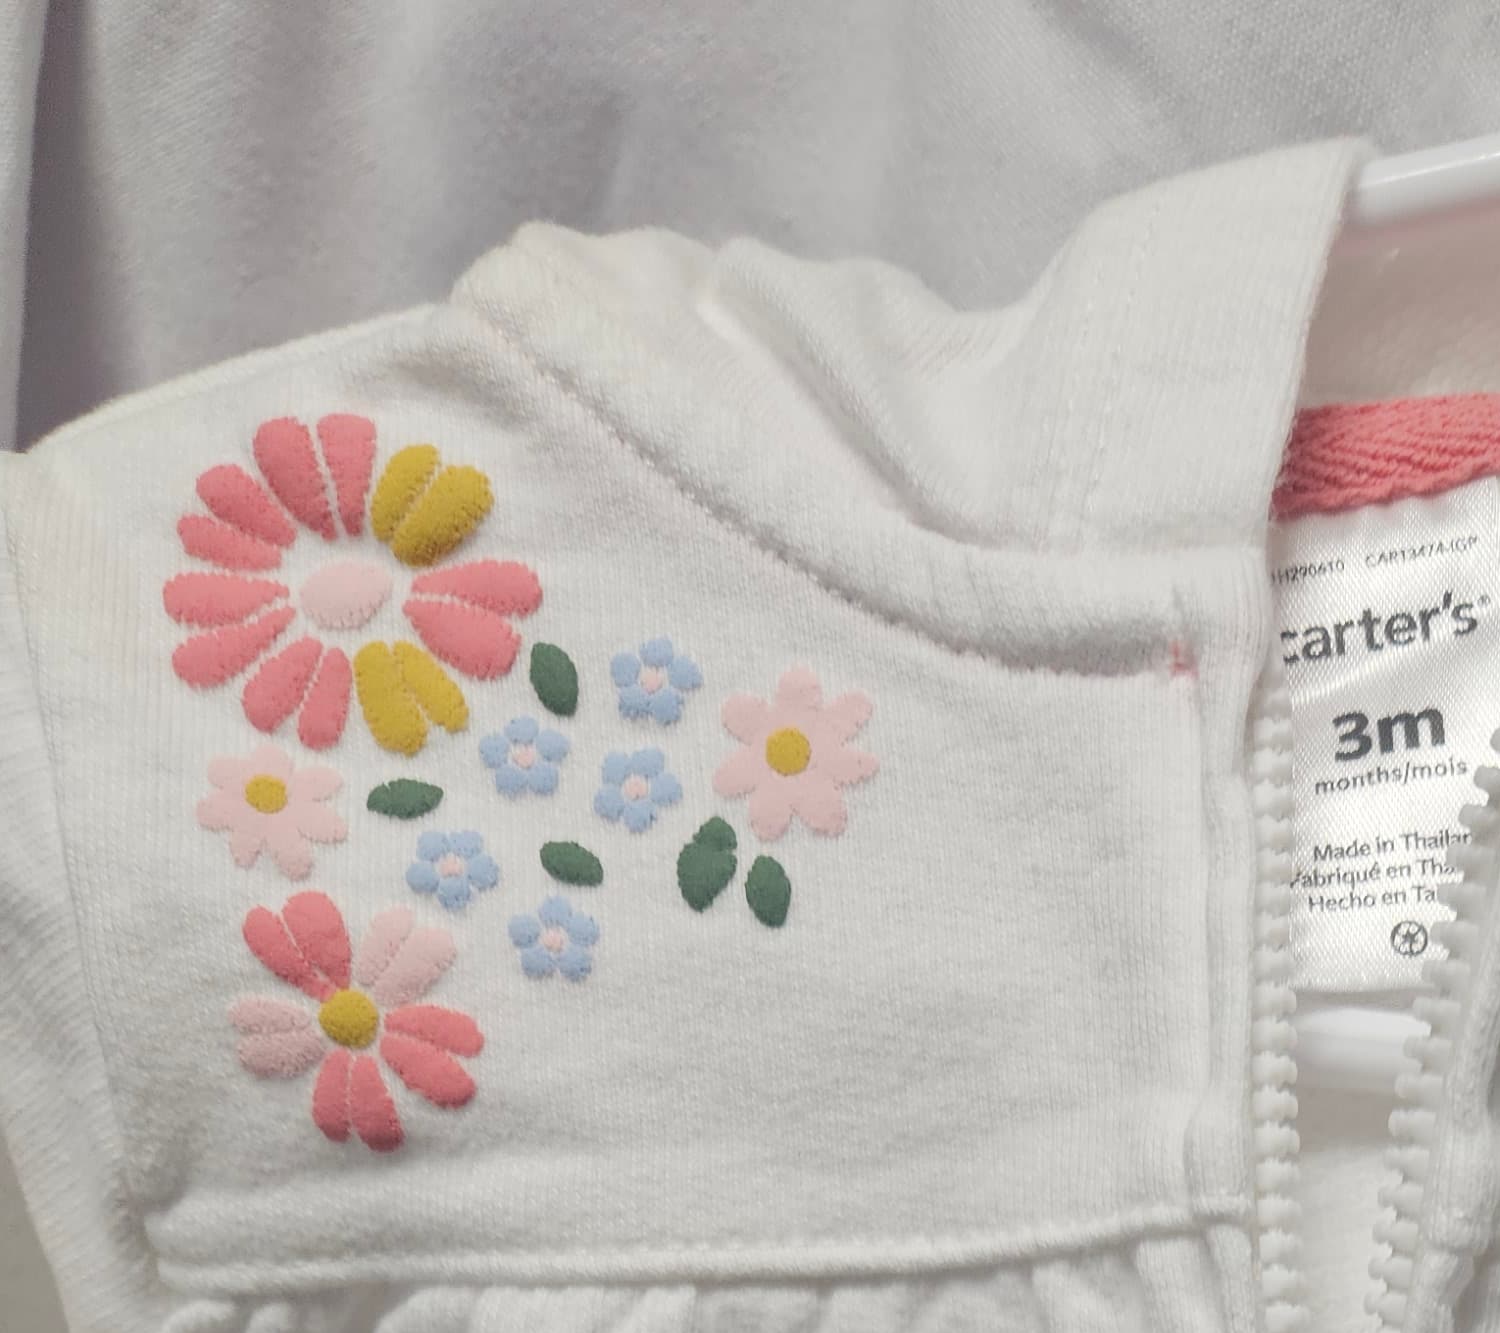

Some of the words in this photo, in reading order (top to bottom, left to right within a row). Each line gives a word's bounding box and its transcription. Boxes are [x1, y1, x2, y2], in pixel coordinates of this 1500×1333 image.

[1332, 707, 1446, 763] 3m
[1314, 755, 1468, 795] months/mois
[1313, 838, 1371, 862] Made
[1376, 835, 1395, 852] in
[1386, 864, 1412, 880] en
[1308, 890, 1376, 913] Hecho
[1381, 890, 1407, 905] en
